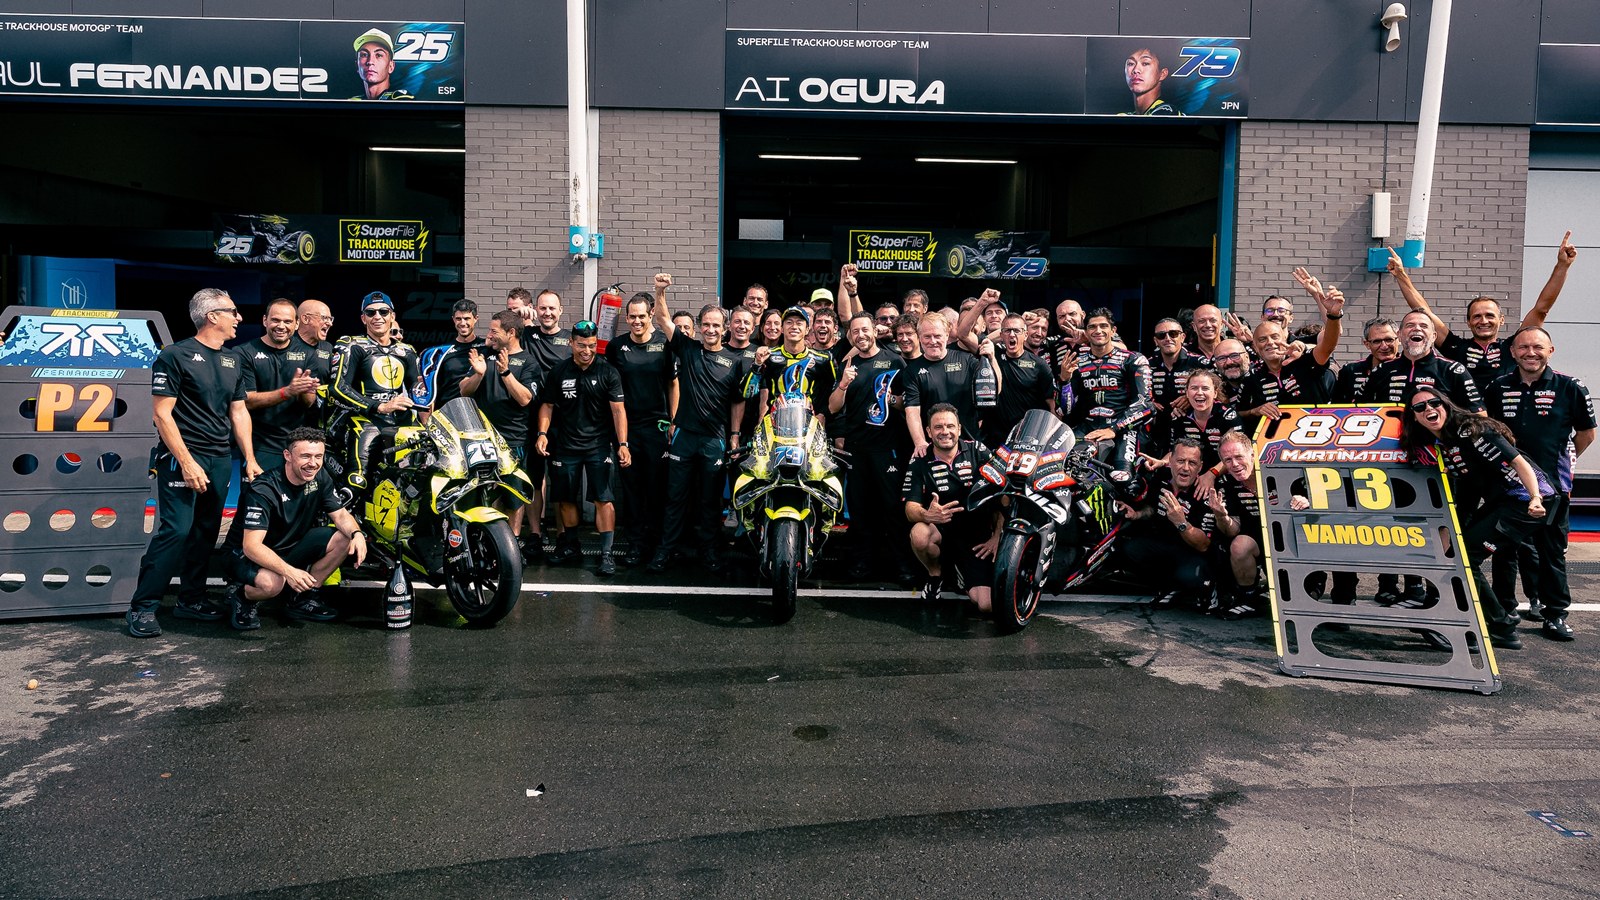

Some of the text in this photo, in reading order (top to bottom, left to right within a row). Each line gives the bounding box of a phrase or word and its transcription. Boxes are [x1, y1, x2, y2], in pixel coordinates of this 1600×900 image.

[5, 22, 68, 32] TRACKHOUSE
[116, 25, 143, 33] TEAM
[393, 32, 454, 61] 25
[737, 37, 790, 47] SUPERFILE
[791, 38, 855, 48] TRACKHOUSE
[902, 41, 930, 49] TEAM
[1171, 46, 1241, 78] 79
[0, 61, 328, 93] UL FERNANDEZ
[437, 86, 456, 95] ESP
[735, 76, 945, 104] AI OGURA
[1221, 101, 1240, 110] JPN
[217, 235, 253, 255] 25
[347, 238, 415, 250] TRACKHOUSE
[388, 249, 415, 260] TEAM
[856, 248, 924, 261] TRACKHOUSE
[896, 260, 923, 271] TEAM
[1002, 256, 1048, 278] 79
[62, 310, 110, 318] TRACKHOUSE
[43, 369, 115, 377] FERNANDEZ
[1083, 374, 1118, 390] aprilia
[36, 383, 115, 432] P2
[1288, 413, 1385, 447] 89
[1281, 448, 1408, 463] MARTINATOR
[1302, 524, 1427, 547] VAMOOOS
